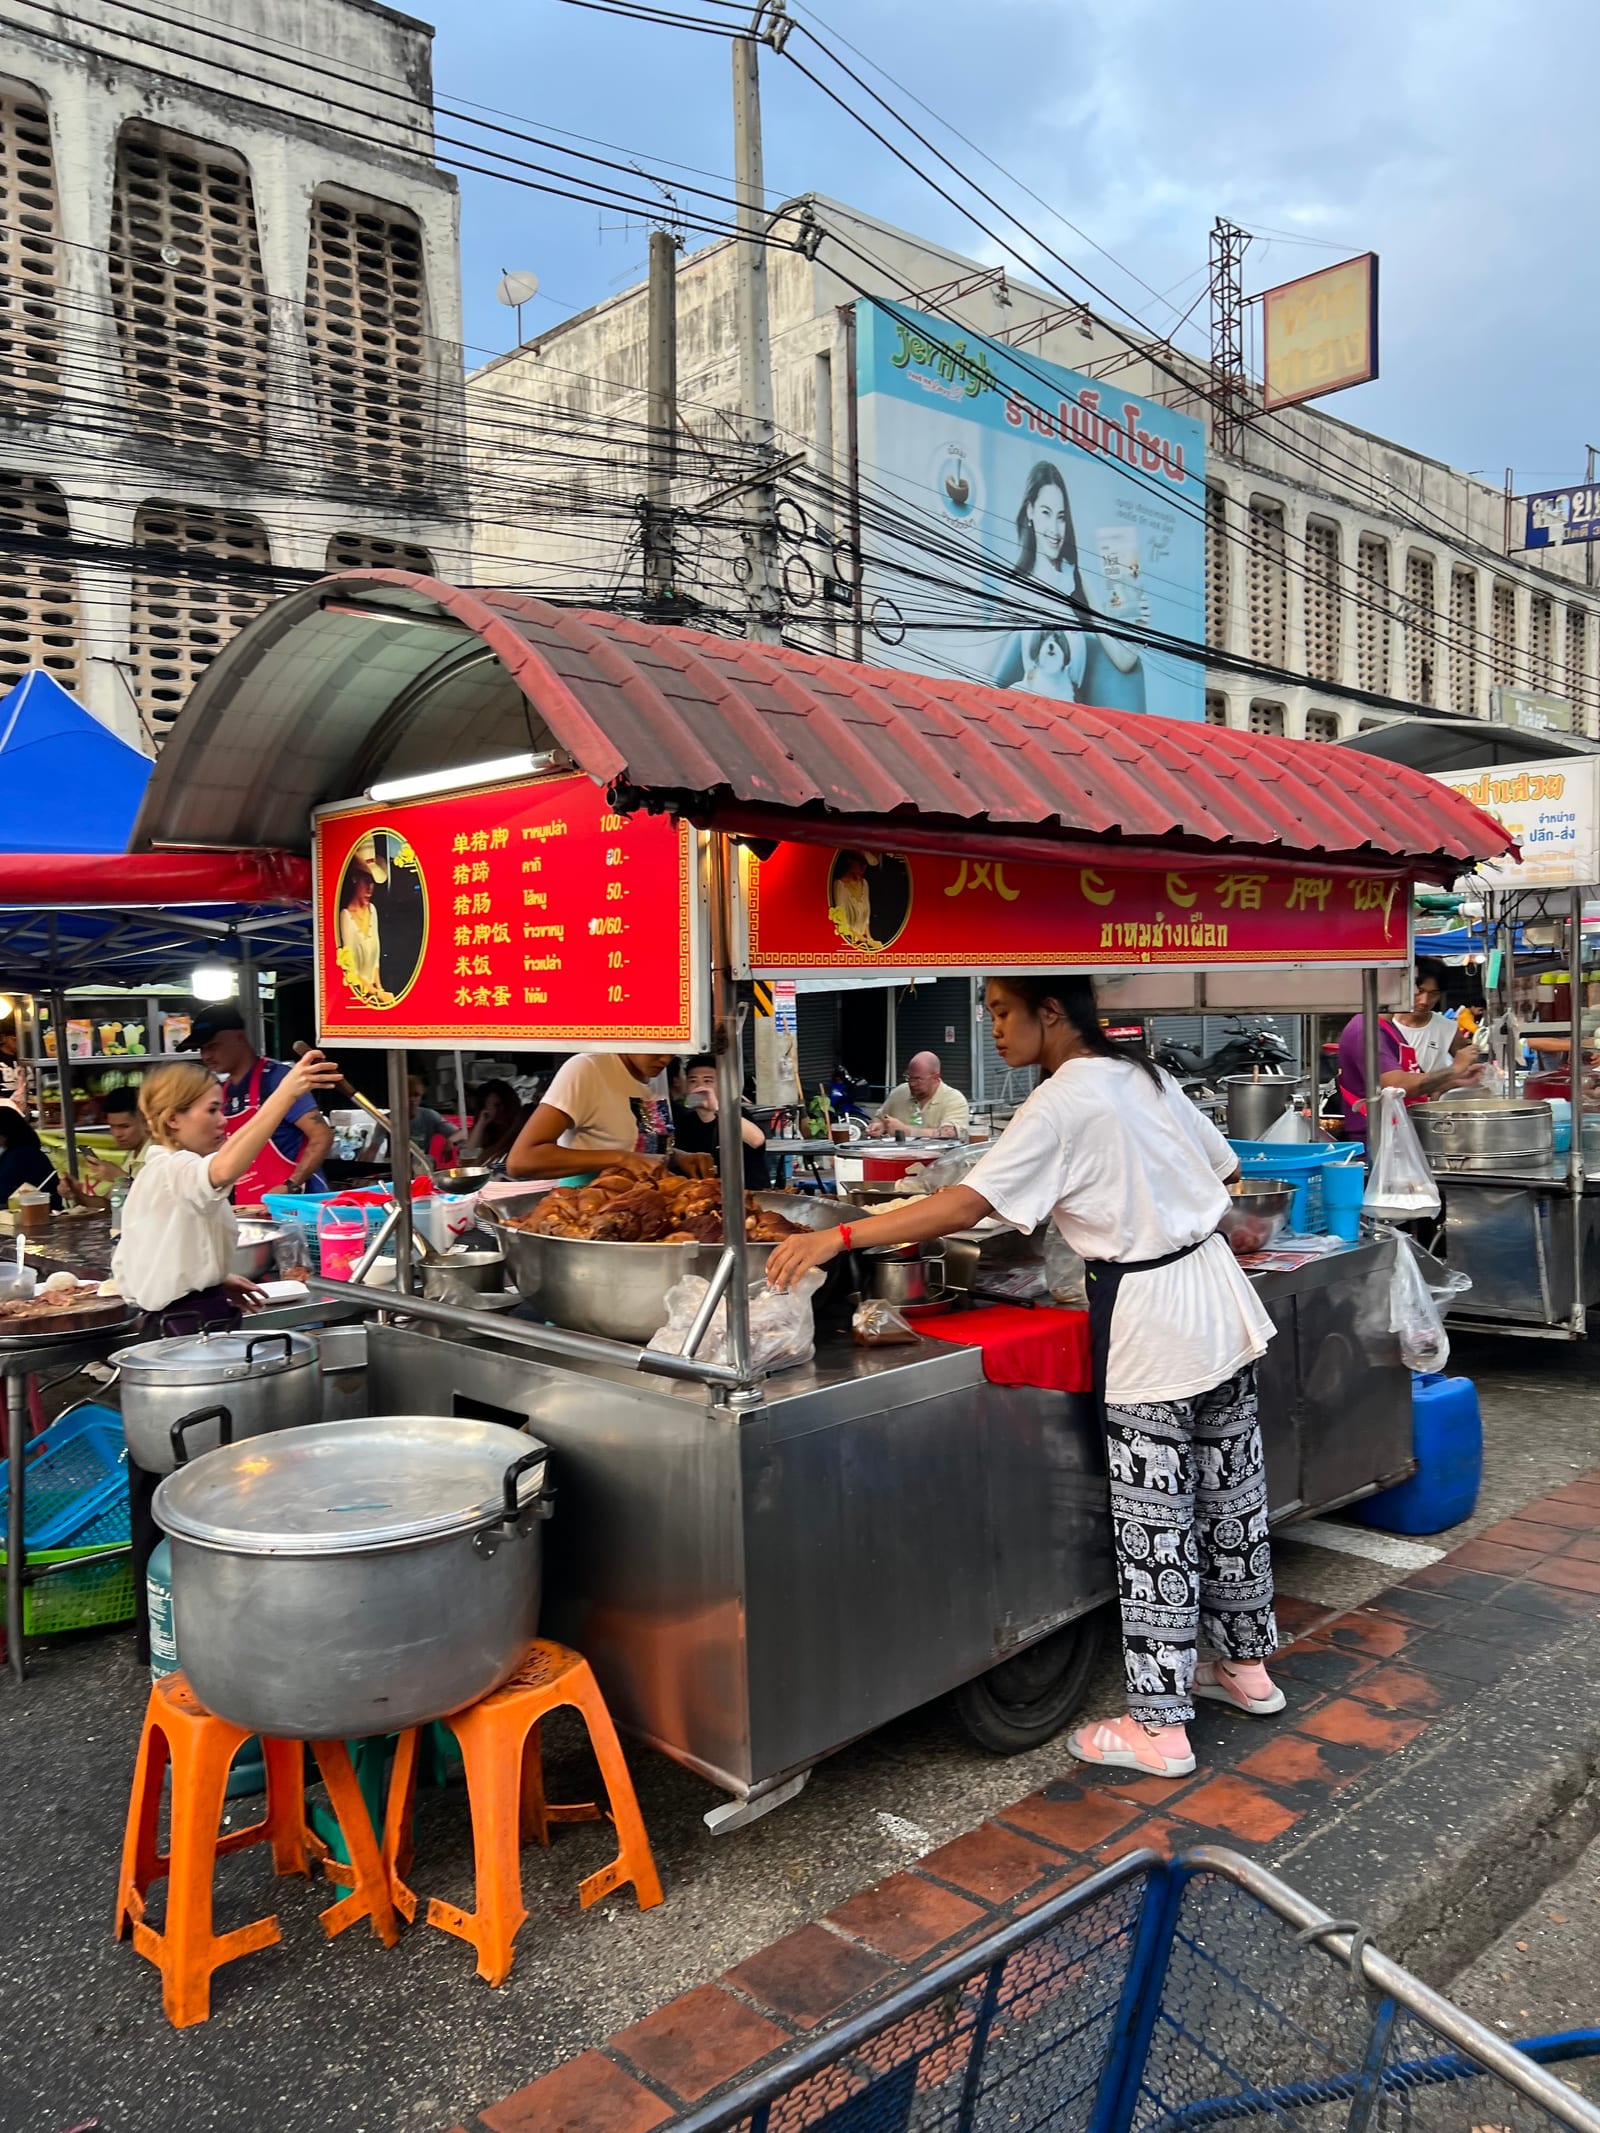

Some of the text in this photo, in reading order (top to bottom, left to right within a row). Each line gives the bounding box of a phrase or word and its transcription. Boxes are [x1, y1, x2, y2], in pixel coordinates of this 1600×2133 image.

[452, 827, 510, 855] 单猪脚
[453, 860, 490, 885] 猪蹄
[606, 882, 630, 900] 50.-
[453, 892, 492, 916] 猪肠
[453, 922, 512, 946] 猪脚饭
[453, 954, 492, 977] 米饭
[608, 951, 630, 968] 10.-
[453, 985, 512, 1007] 水煮蛋
[608, 985, 630, 1002] 10.-
